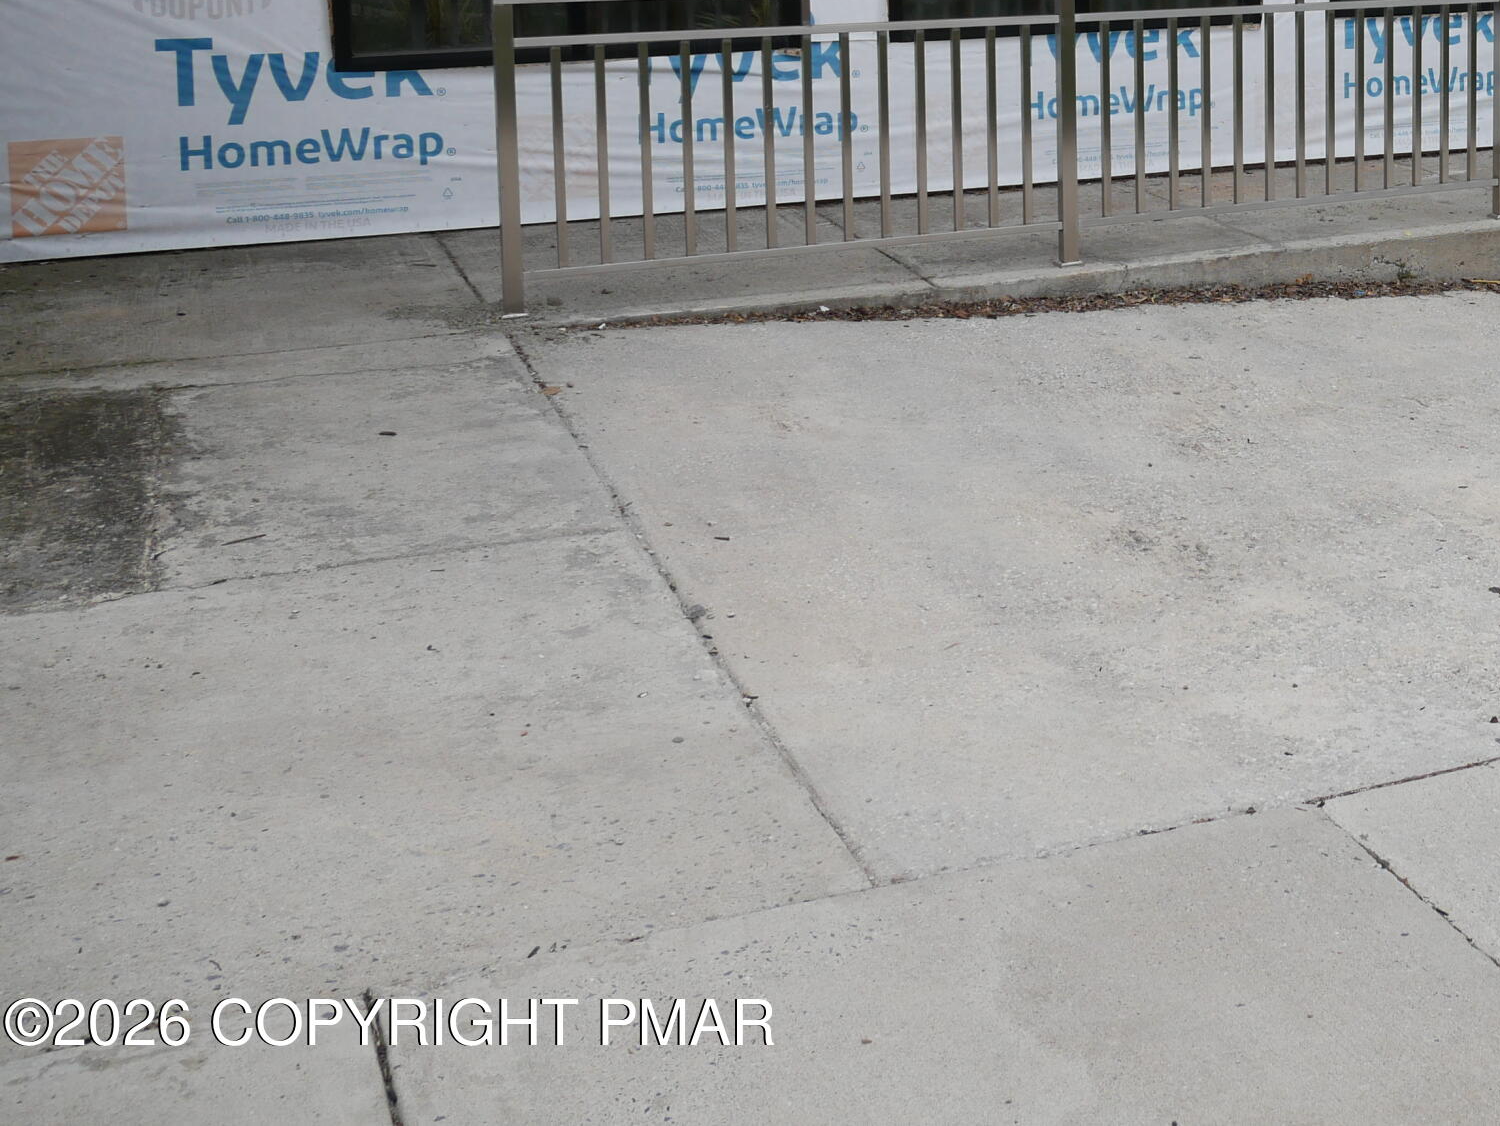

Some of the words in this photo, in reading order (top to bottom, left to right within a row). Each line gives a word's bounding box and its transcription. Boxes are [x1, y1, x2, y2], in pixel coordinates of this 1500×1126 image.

[24, 150, 70, 190] THE
[179, 126, 443, 171] HomeWrap
[13, 137, 123, 234] HOME
